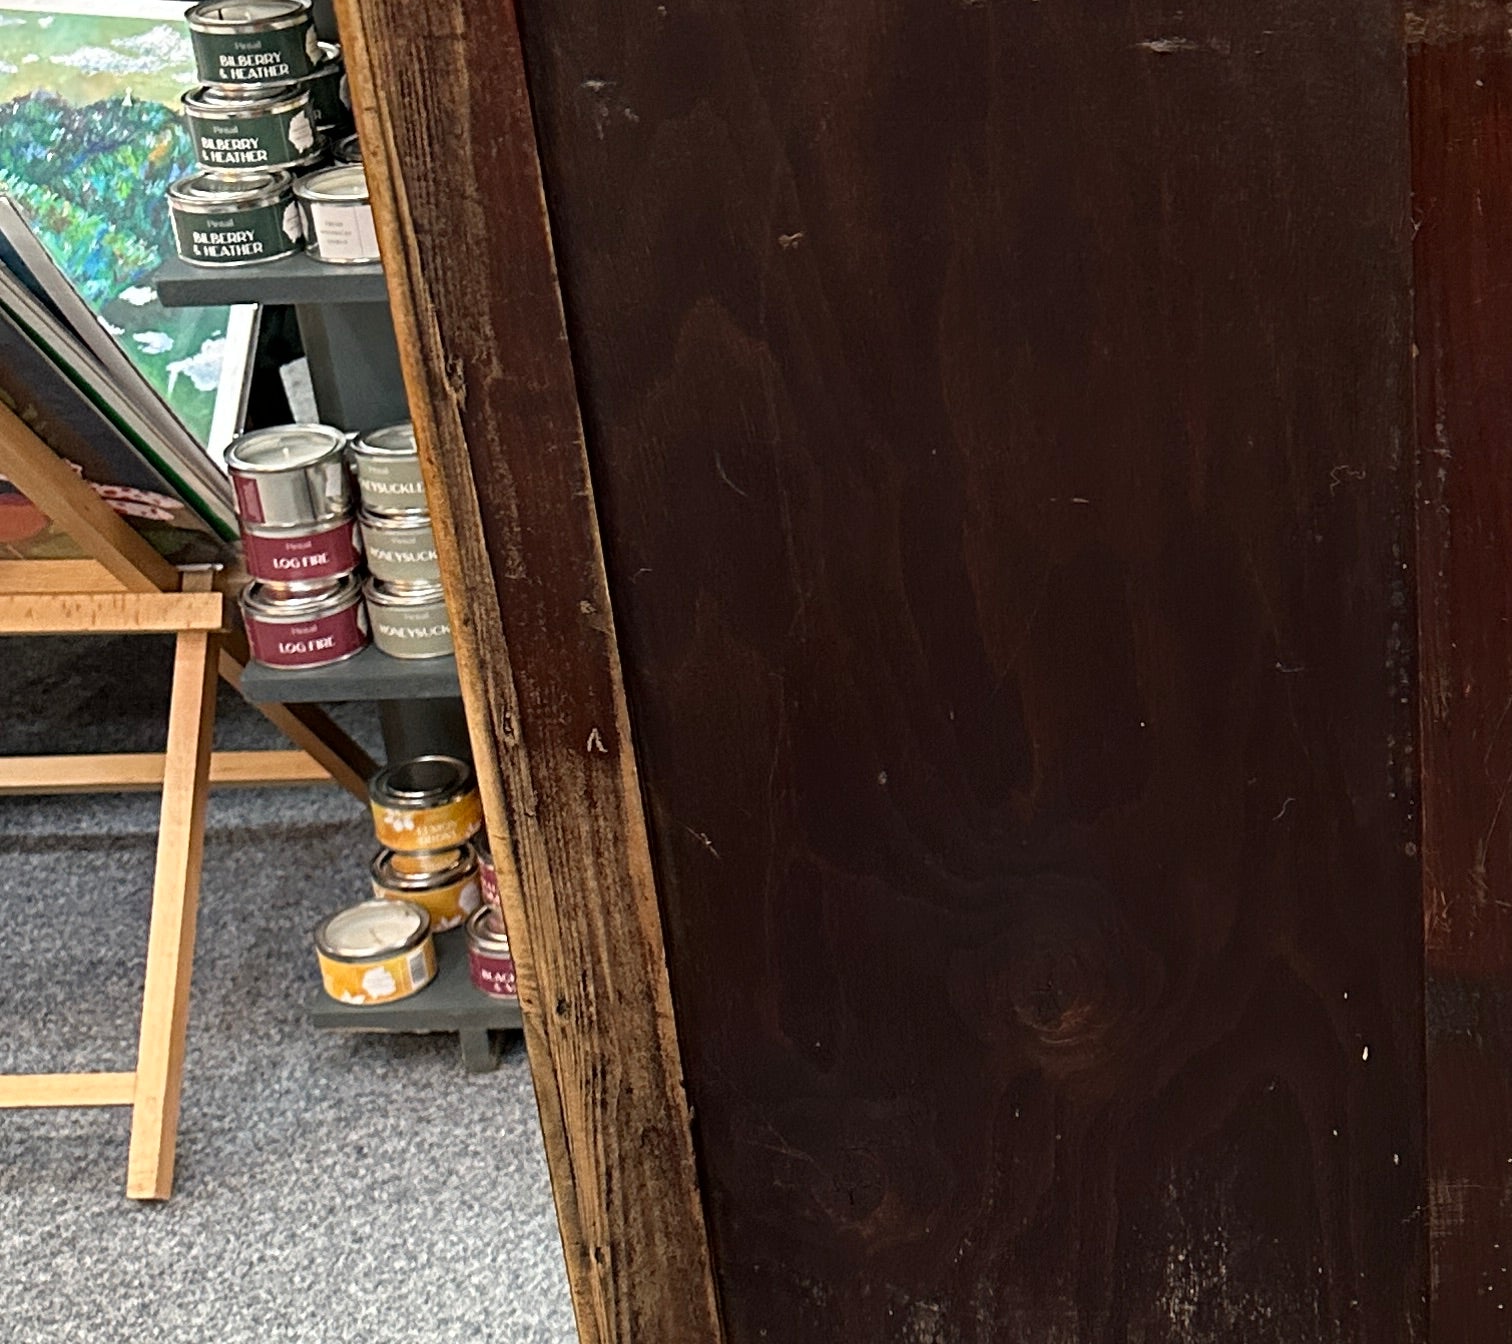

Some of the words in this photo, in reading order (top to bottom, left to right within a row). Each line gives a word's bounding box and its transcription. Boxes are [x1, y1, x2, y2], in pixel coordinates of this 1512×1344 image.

[219, 52, 281, 68] BILBERRY
[219, 67, 228, 80] &
[230, 64, 289, 80] HEATHER
[201, 137, 260, 151] BILBERRY
[202, 151, 211, 162] &
[211, 150, 268, 163] HEATHER
[192, 229, 255, 244] BILBERRY
[193, 244, 202, 256] &
[203, 242, 264, 257] HEATHER
[273, 556, 301, 569] LOG
[302, 552, 330, 568] FIRE
[278, 641, 304, 654] LOG
[307, 637, 336, 652] FIRE
